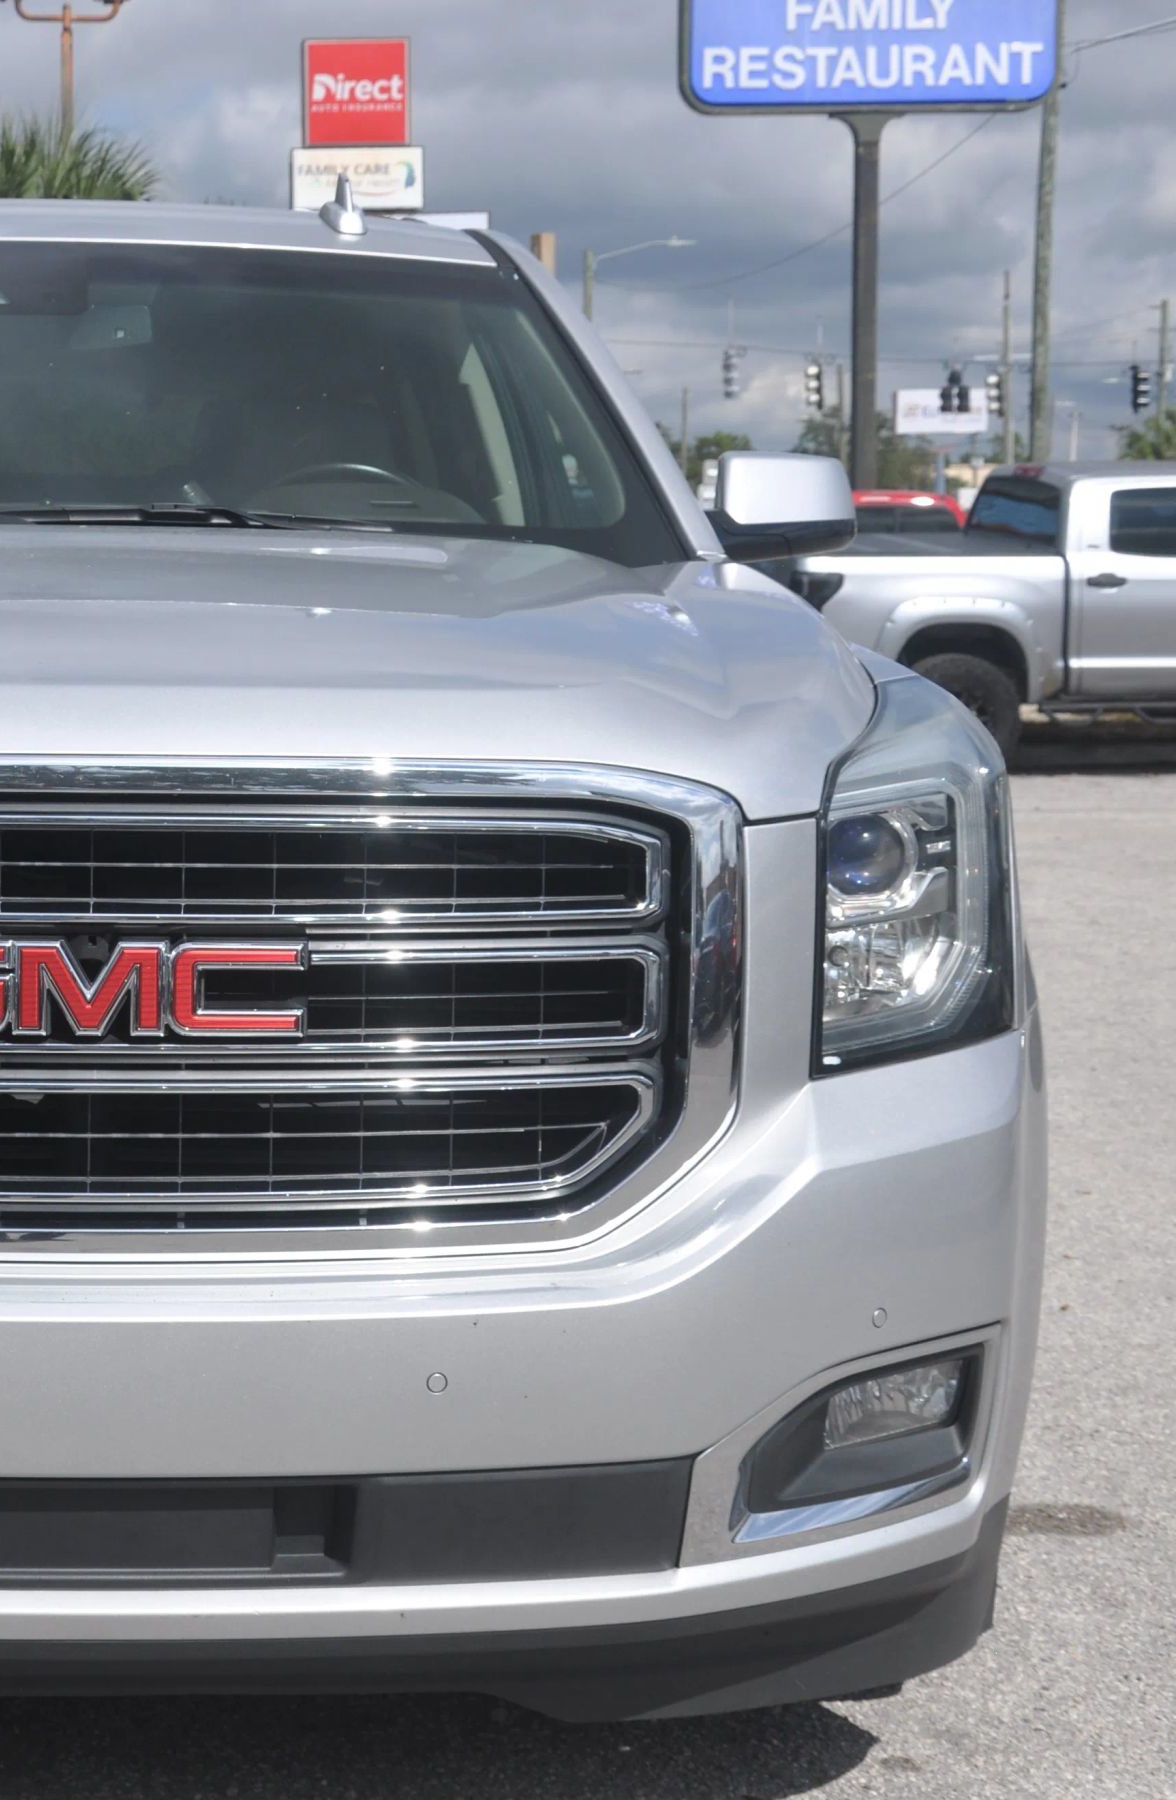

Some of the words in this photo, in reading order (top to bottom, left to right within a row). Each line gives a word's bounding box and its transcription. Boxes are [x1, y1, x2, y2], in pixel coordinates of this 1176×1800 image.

[784, 0, 954, 31] FAMILY
[702, 42, 1045, 90] RESTAURANT
[312, 73, 403, 101] Direct
[354, 163, 390, 176] CARE
